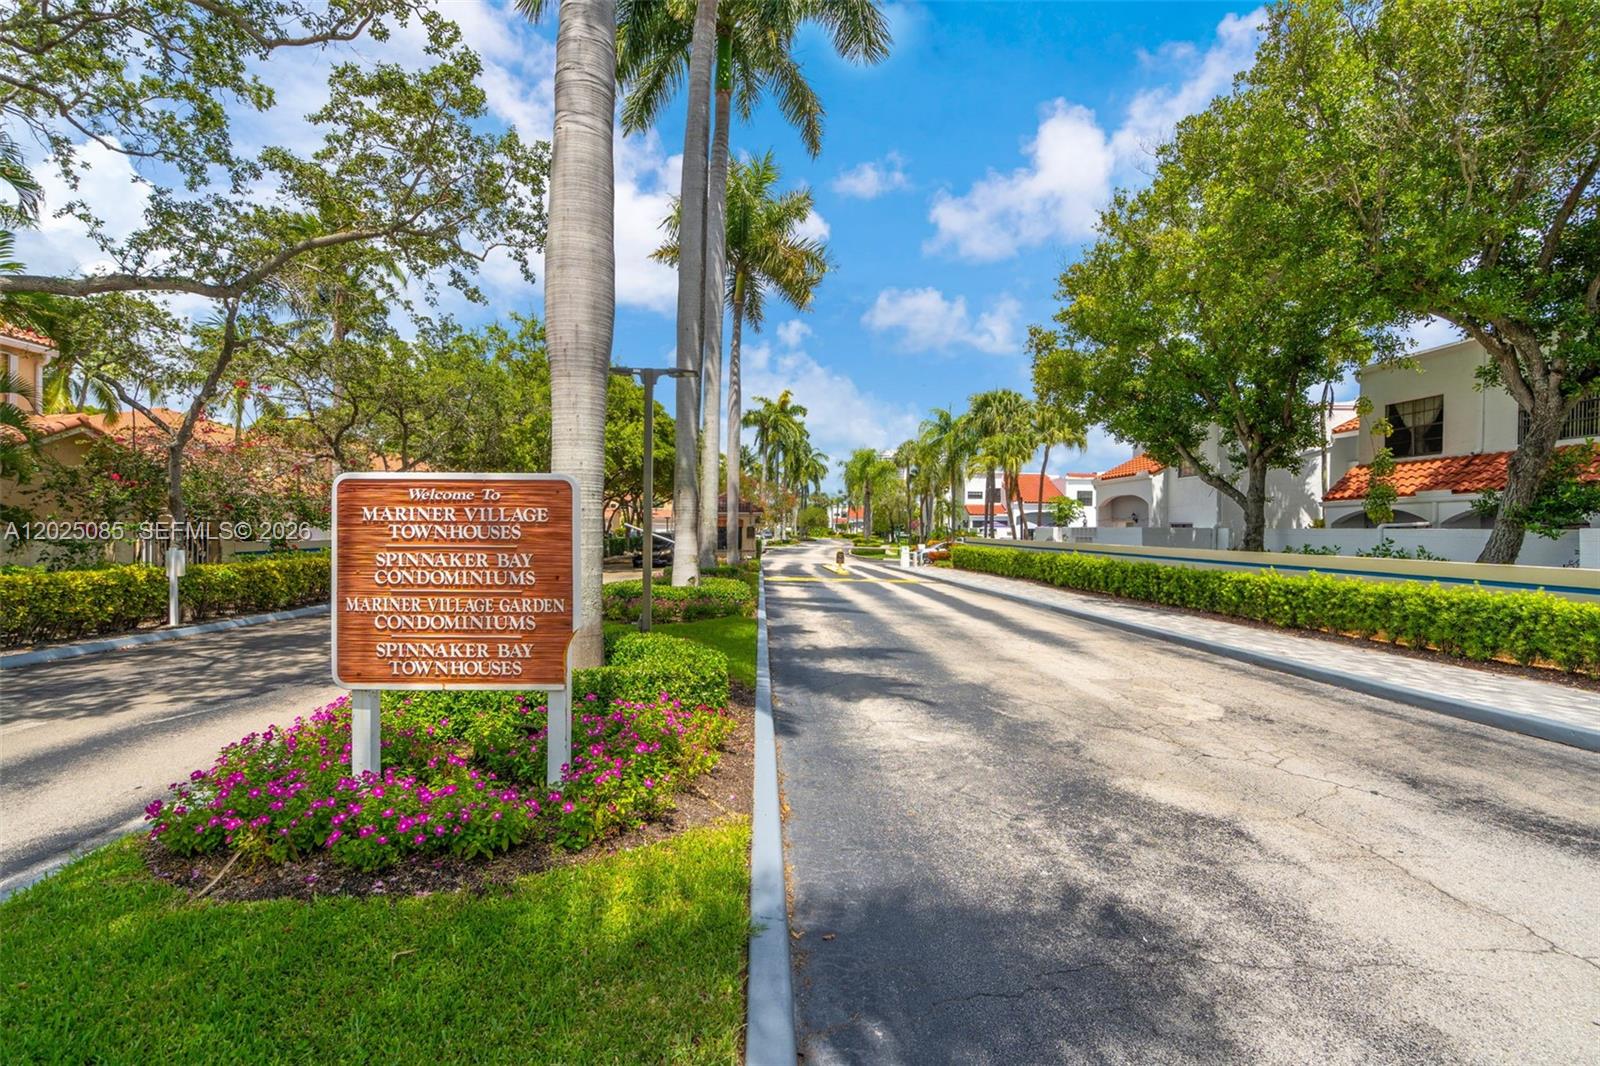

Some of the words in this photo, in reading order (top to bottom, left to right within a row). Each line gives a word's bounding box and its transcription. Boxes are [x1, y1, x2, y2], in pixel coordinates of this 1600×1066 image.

[408, 488, 474, 501] Welcome
[482, 488, 501, 501] To
[362, 507, 456, 522] MARINER
[465, 507, 549, 522] VILLAGE
[388, 524, 522, 540] TOWNHOUSES
[376, 553, 488, 568] SPINNAKER
[498, 553, 534, 568] BAY
[374, 570, 536, 586] CONDOMINIUMS
[346, 597, 421, 612] MARINER
[428, 597, 494, 613] VILLAGE
[499, 597, 565, 613] GARDEN
[374, 615, 536, 630] CONDOMINIUMS
[376, 643, 488, 658] SPINNAKER
[498, 643, 534, 658] BAY
[389, 660, 522, 676] TOWNHOUSES
